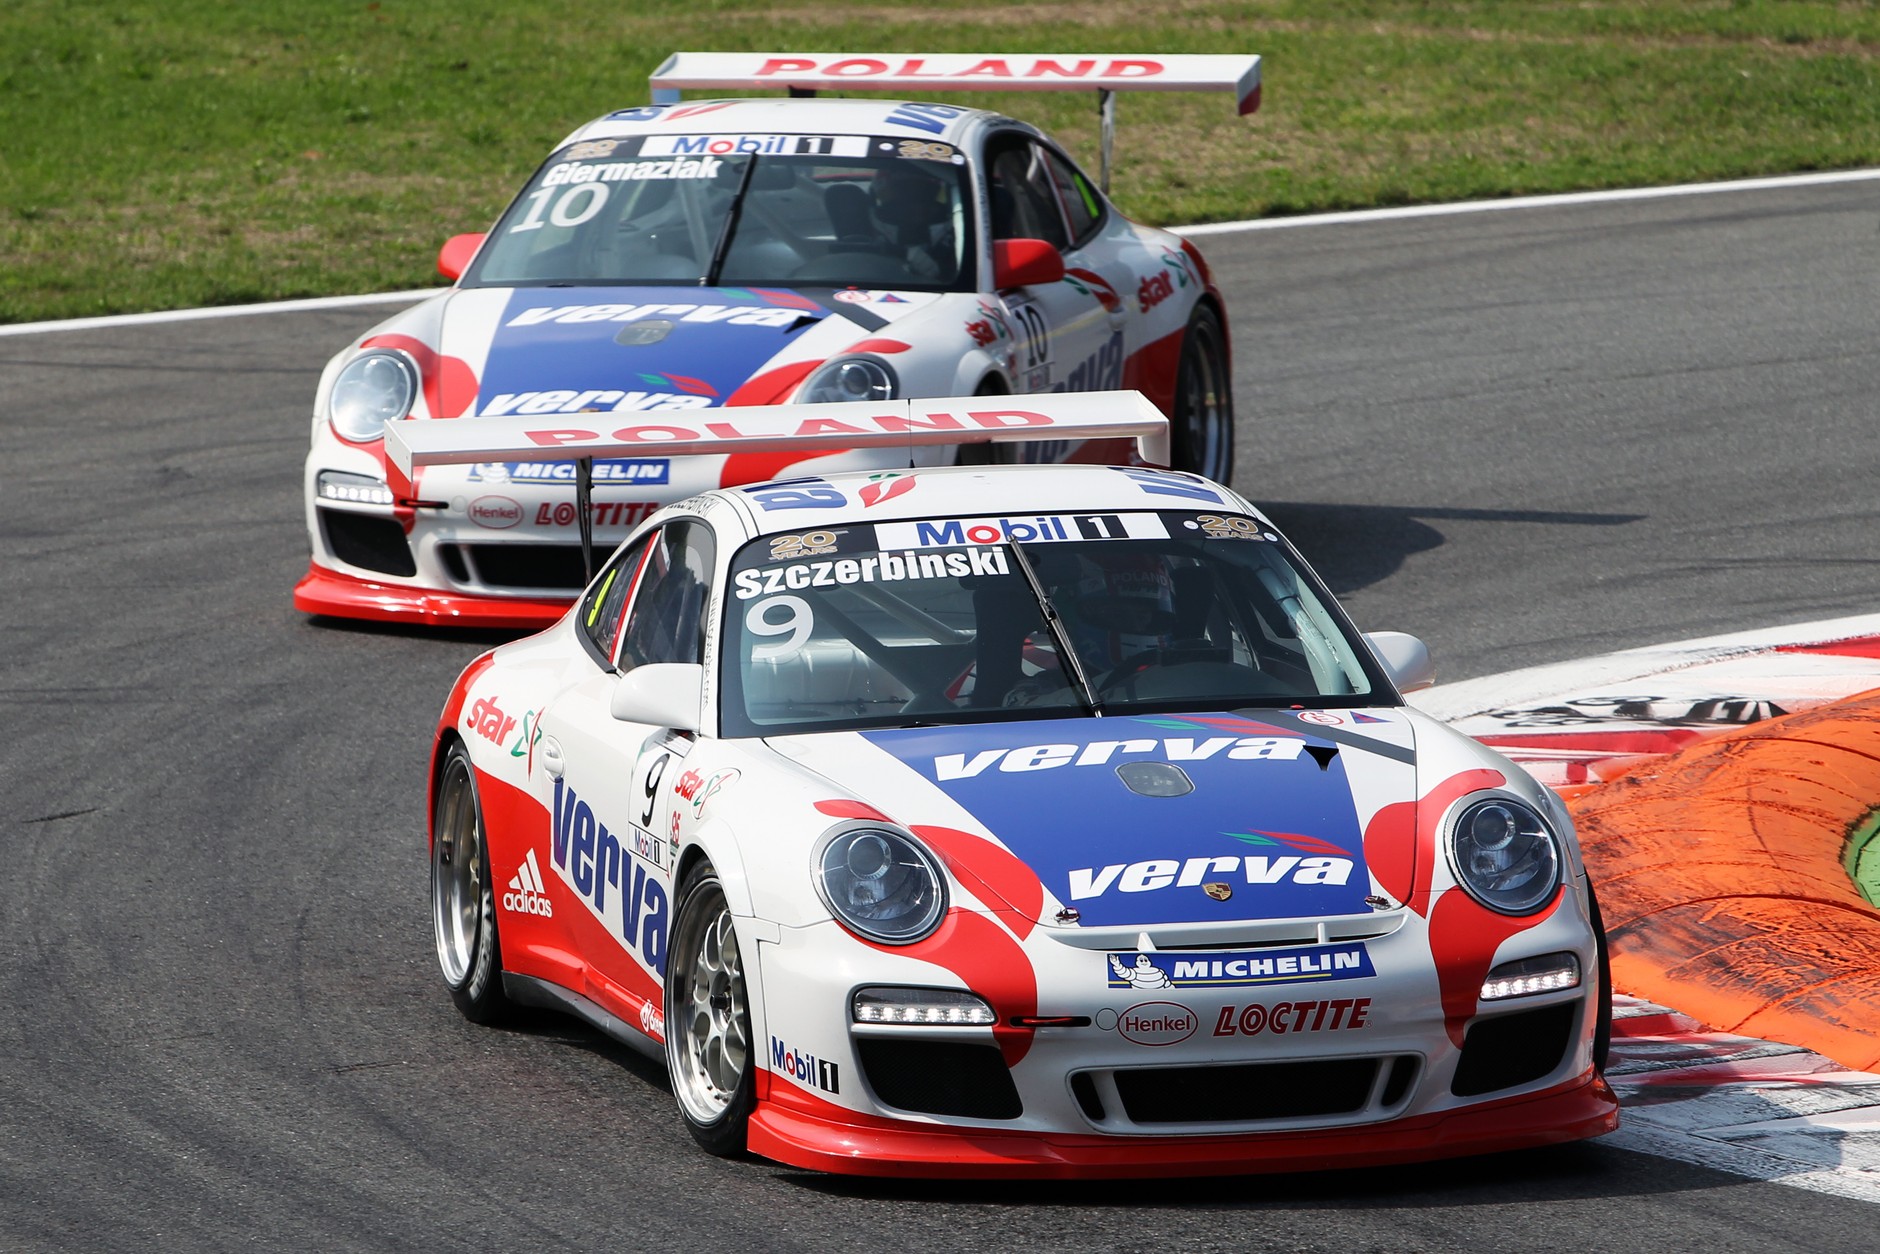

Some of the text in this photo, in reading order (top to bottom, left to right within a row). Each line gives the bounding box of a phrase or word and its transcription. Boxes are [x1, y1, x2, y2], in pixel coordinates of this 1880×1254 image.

[752, 58, 1164, 78] POLAND
[671, 136, 822, 155] Mobil 1
[541, 155, 723, 188] Giermaziak
[510, 182, 610, 235] 10
[1137, 269, 1174, 315] star
[506, 303, 812, 328] verva
[1014, 304, 1048, 367] 10
[480, 390, 713, 417] verva
[525, 411, 1055, 447] POLAND
[513, 463, 665, 479] MICELIN
[473, 505, 519, 519] Henkel
[1196, 515, 1259, 534] 20
[769, 530, 837, 555] 20
[918, 515, 1116, 545] Mobil 1
[771, 545, 838, 560] YEARS
[735, 546, 1010, 600] Szczerbinski
[1111, 570, 1169, 587] POLAND
[745, 595, 814, 662] 9
[466, 696, 516, 747] star
[934, 735, 1308, 782] verva
[641, 753, 671, 828] 9
[634, 828, 653, 861] Mobil
[553, 777, 668, 979] verva
[1068, 856, 1354, 901] verva
[503, 887, 553, 919] adidas
[1173, 951, 1361, 979] MICHELIN
[1124, 1014, 1191, 1033] Henkel
[1213, 998, 1372, 1037] LOCTITE
[771, 1035, 817, 1088] Mobil
